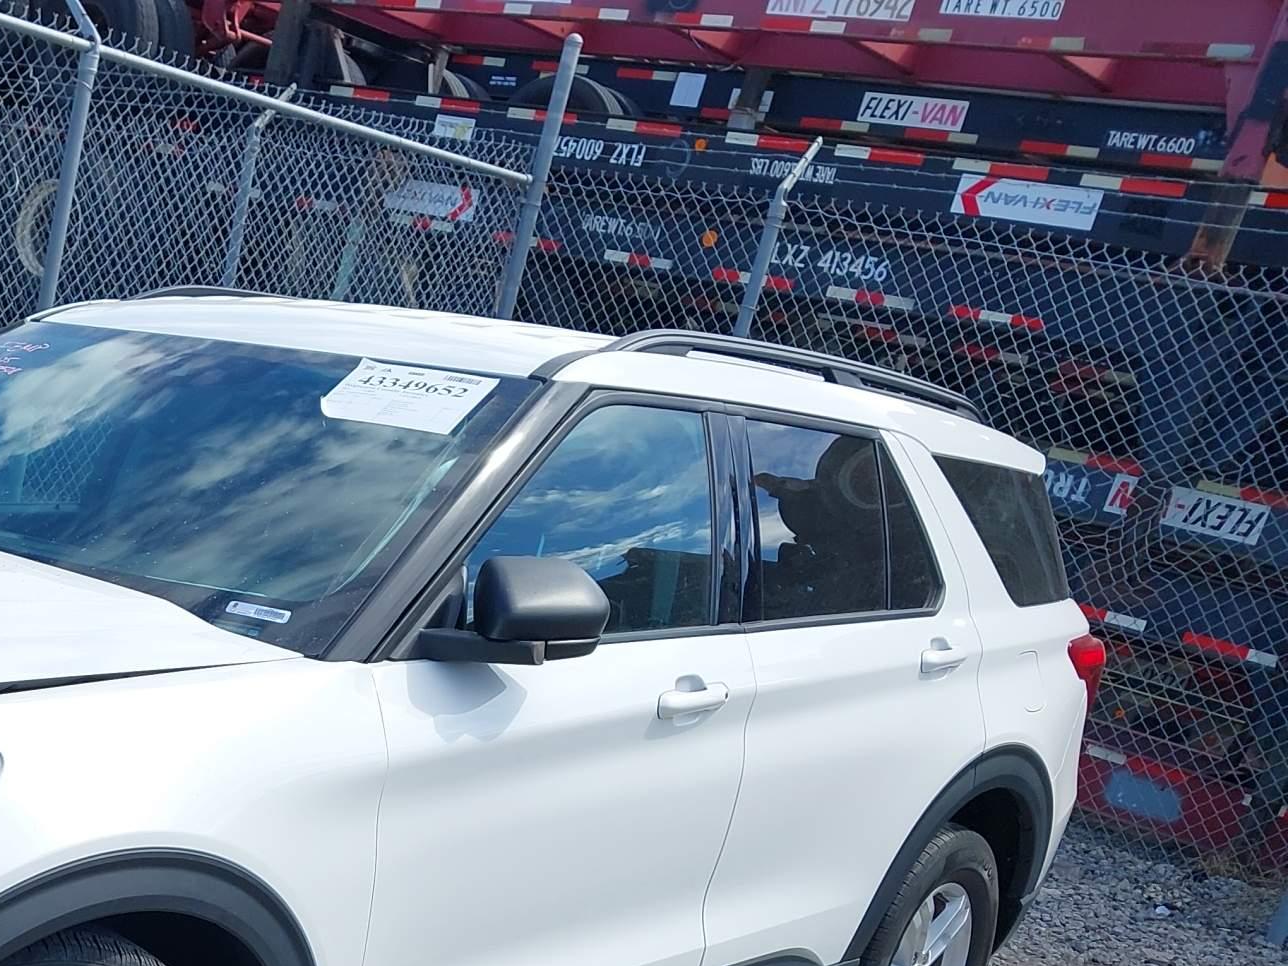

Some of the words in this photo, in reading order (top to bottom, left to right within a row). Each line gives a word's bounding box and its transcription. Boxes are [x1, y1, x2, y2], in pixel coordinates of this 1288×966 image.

[1016, 1, 1062, 18] 6500
[552, 135, 604, 161] 600457
[1107, 130, 1138, 149] TARE
[609, 142, 647, 167] FLXZ
[771, 242, 811, 269] LXZ
[816, 250, 890, 281] 413456
[358, 375, 469, 398] 43349652
